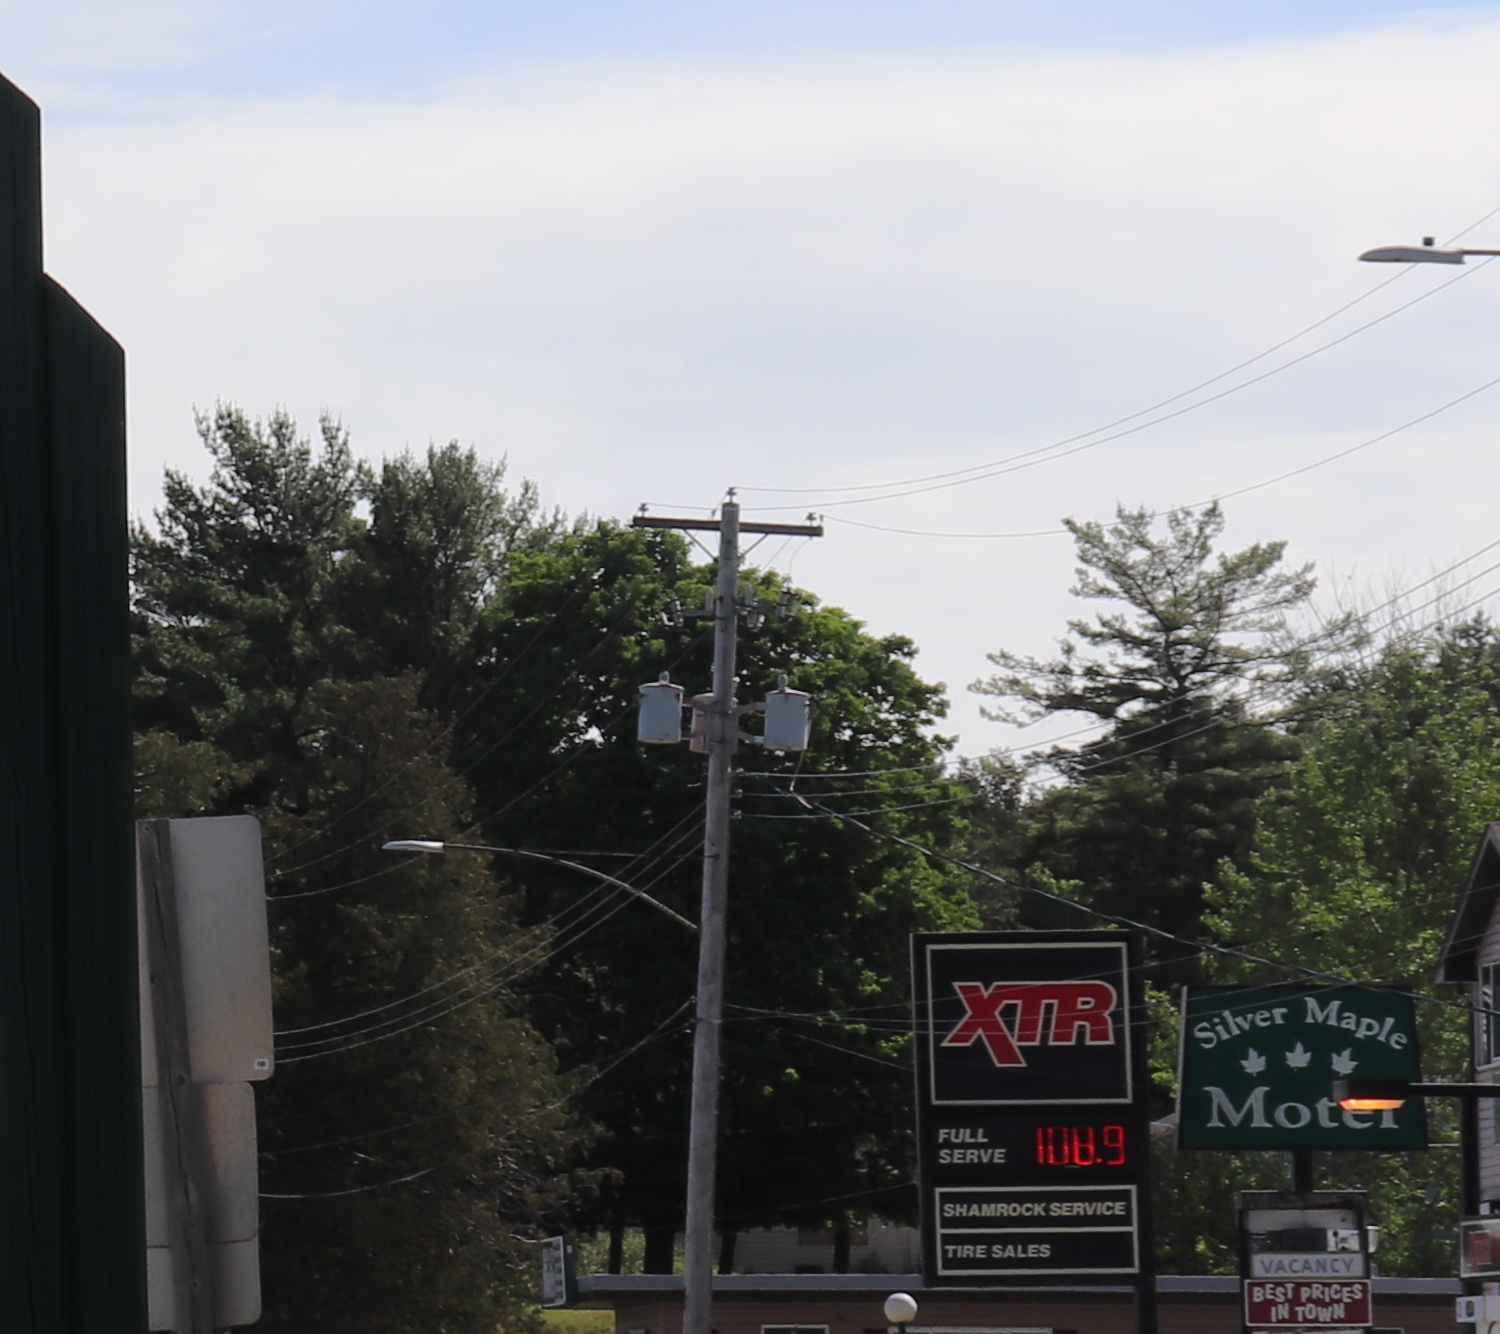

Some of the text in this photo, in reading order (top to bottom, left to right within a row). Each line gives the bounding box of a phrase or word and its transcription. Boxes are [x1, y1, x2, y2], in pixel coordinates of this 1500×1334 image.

[939, 980, 1117, 1067] XTR
[1193, 996, 1408, 1050] Silver Maple
[938, 1128, 989, 1143] FULL
[1036, 1125, 1126, 1166] 108.9
[938, 1149, 1006, 1164] SERVE
[943, 1201, 1127, 1217] SHAMROCK SERVICE
[944, 1244, 1051, 1258] TIRE SALES
[1260, 1258, 1355, 1274] VACANCY
[1253, 1283, 1363, 1303] BEST PRICES
[1271, 1303, 1345, 1322] IN TOWN
